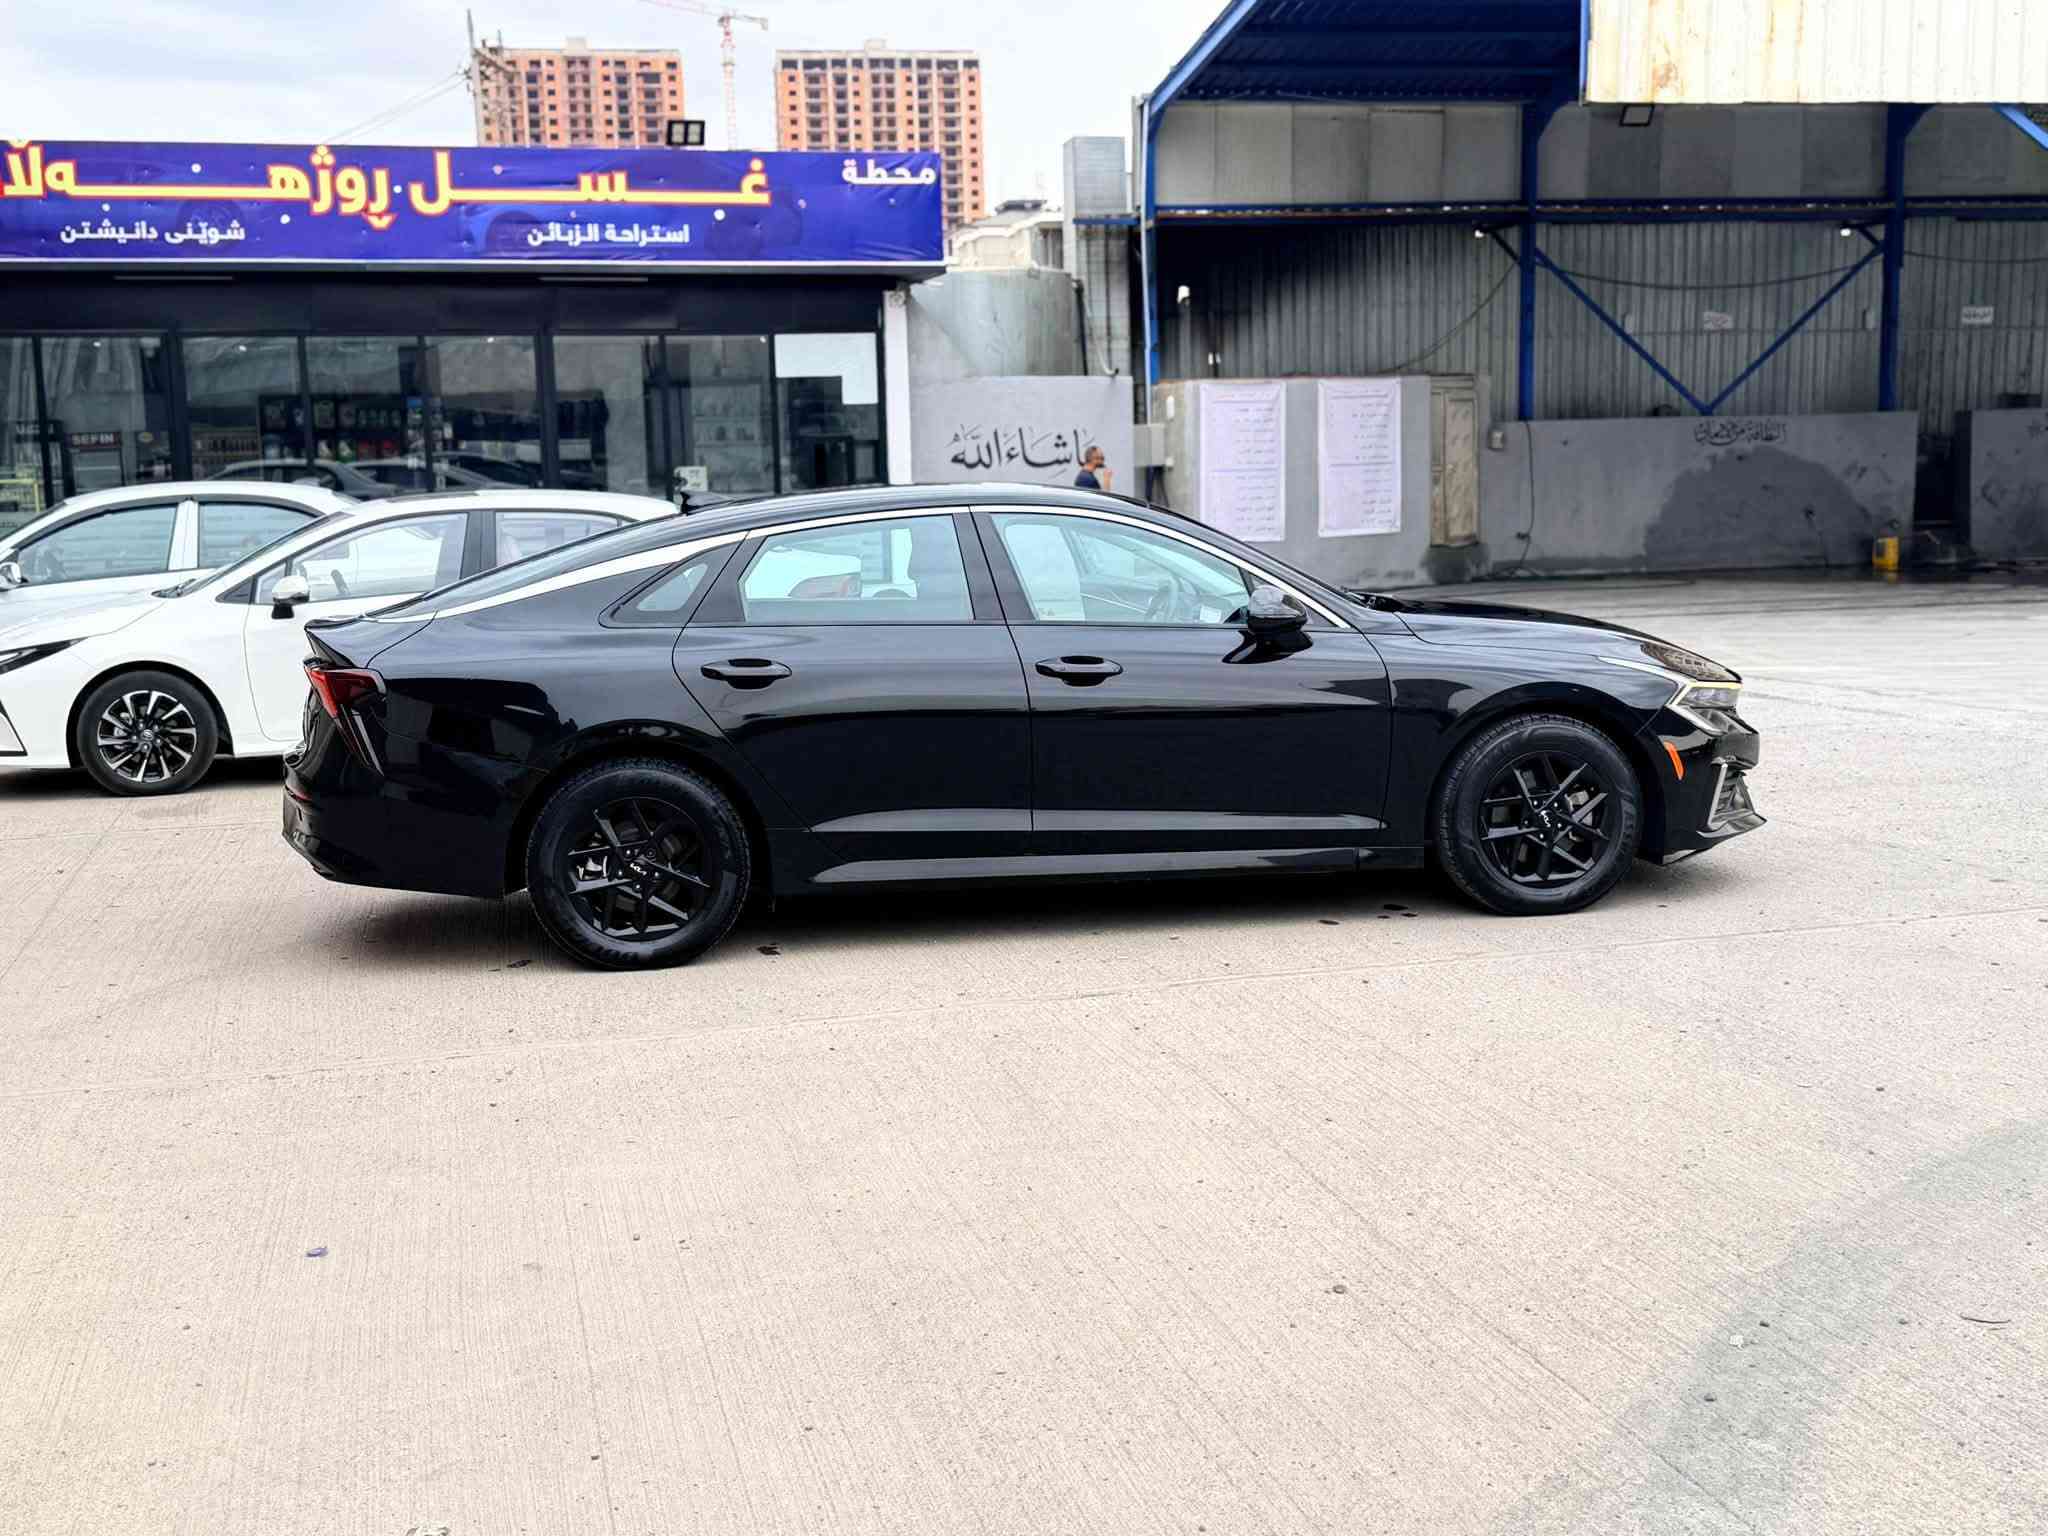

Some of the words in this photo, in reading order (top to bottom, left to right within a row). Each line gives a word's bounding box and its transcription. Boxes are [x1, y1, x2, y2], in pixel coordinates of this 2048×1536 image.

[841, 158, 937, 186] محطة
[526, 221, 600, 247] الزبائن
[604, 223, 691, 247] استراحة
